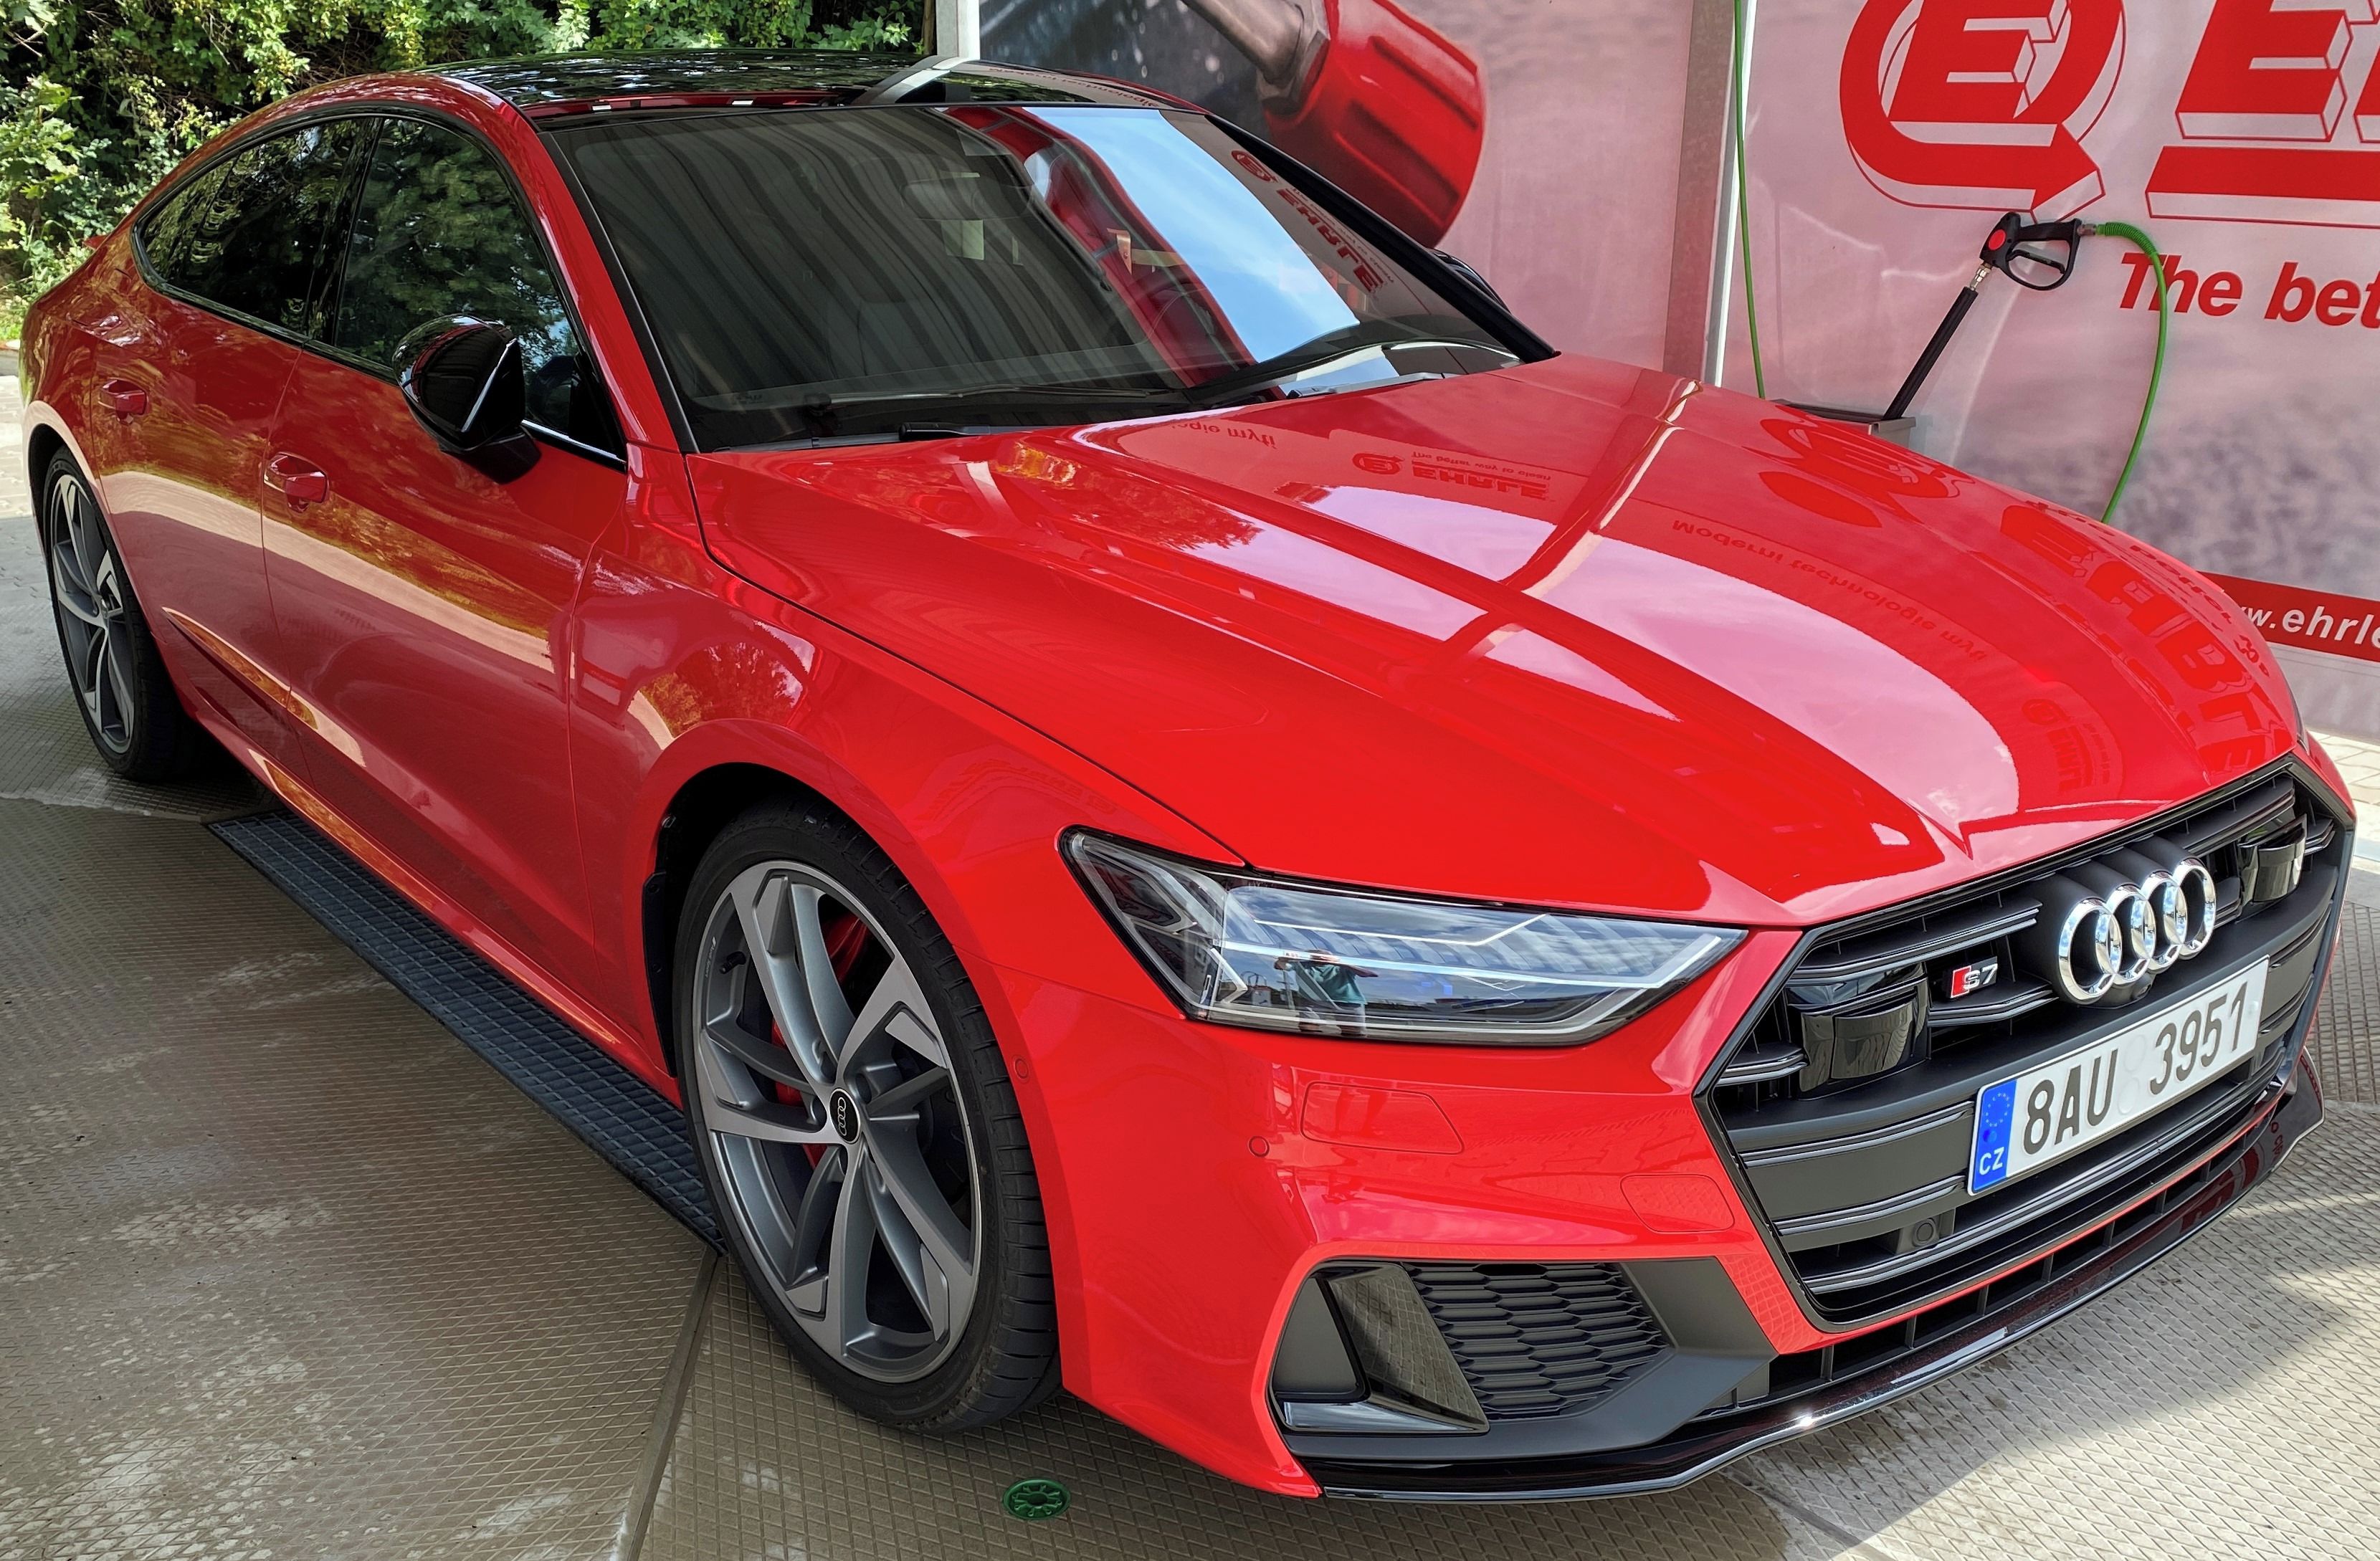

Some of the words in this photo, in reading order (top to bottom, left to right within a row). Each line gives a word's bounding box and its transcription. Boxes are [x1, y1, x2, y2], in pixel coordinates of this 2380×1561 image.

[2176, 0, 2380, 142] E
[2120, 252, 2243, 316] The
[2240, 604, 2380, 649] w.ehrl
[1962, 963, 1999, 990] S7
[2023, 1049, 2118, 1156] 8AU
[2149, 980, 2247, 1096] 3951
[1979, 1147, 2004, 1175] CZ
